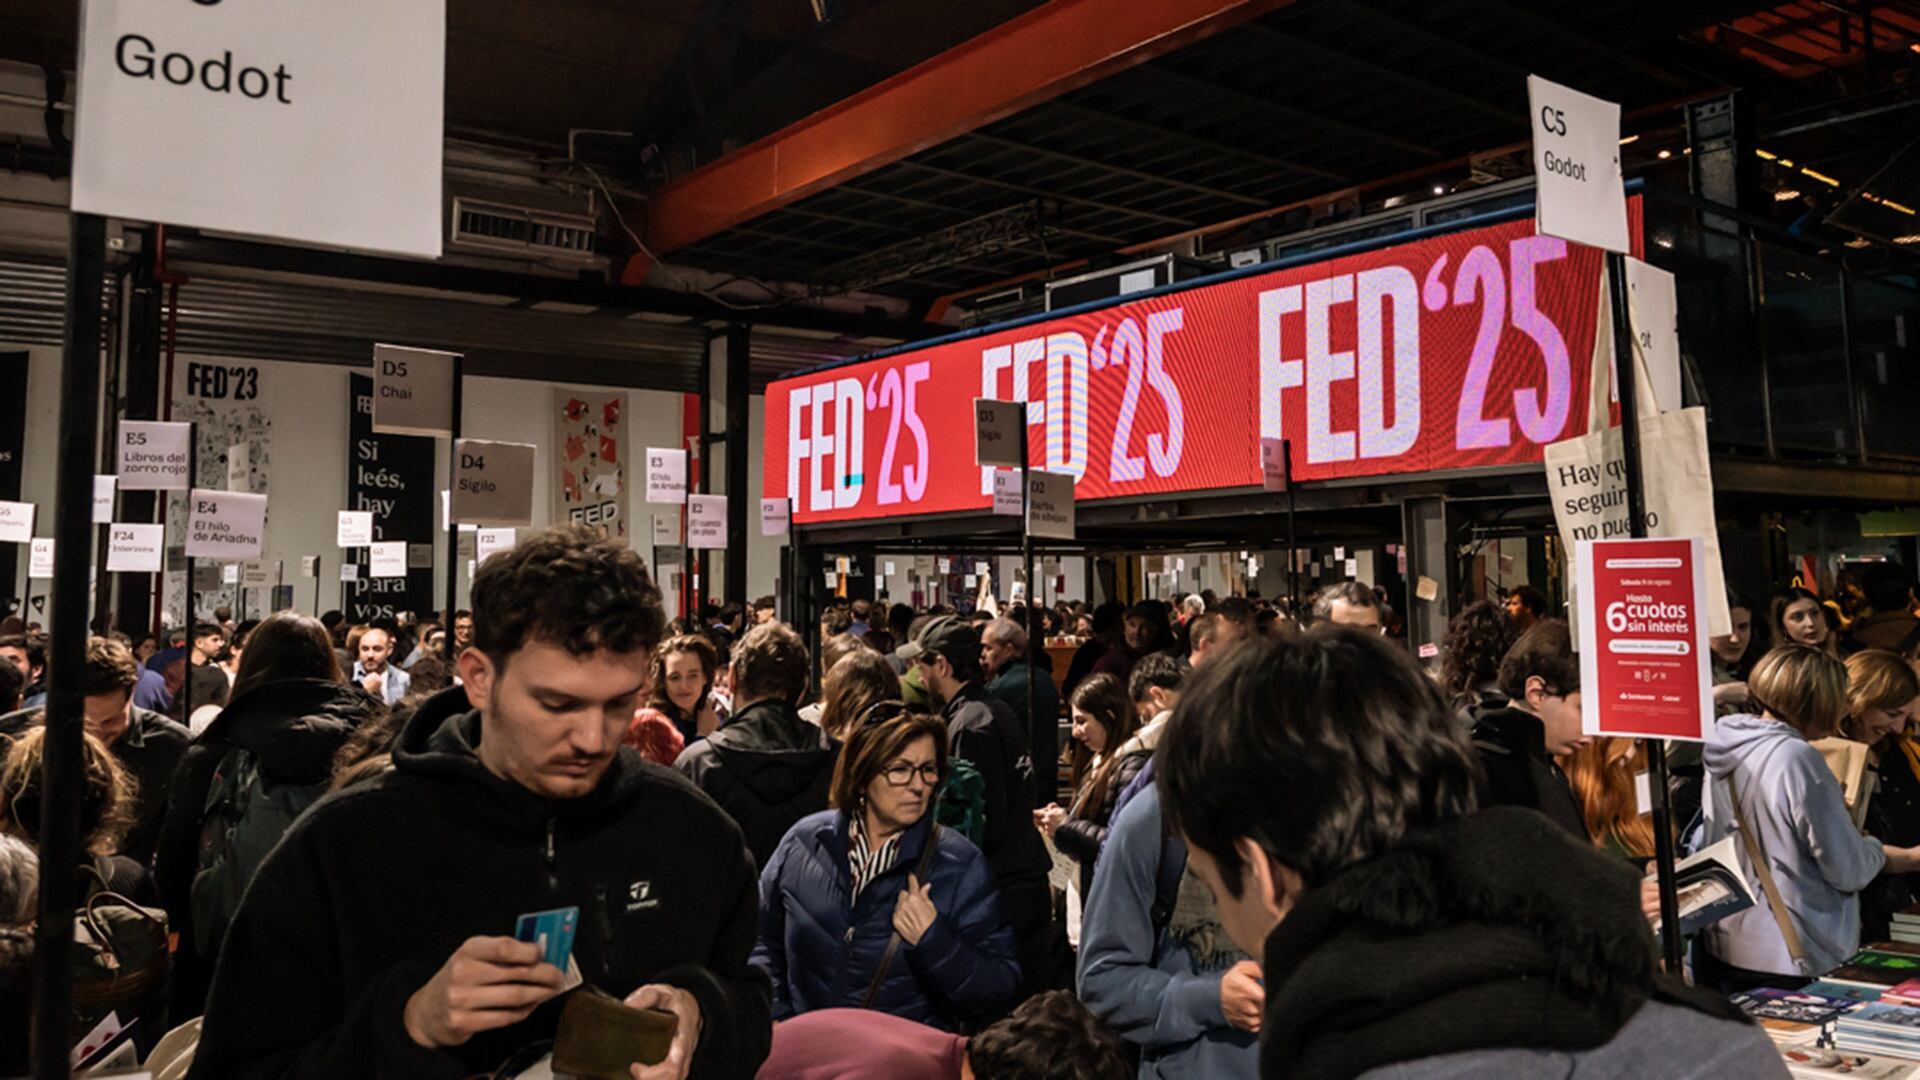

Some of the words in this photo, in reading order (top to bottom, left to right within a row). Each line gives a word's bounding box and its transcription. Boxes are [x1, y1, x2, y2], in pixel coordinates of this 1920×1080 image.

[114, 33, 292, 104] Godot
[1540, 105, 1567, 137] C5
[1543, 150, 1586, 183] Godot
[382, 360, 408, 377] D5
[380, 385, 412, 400] Chai
[357, 395, 372, 414] FE
[125, 432, 147, 446] E5
[124, 452, 165, 463] Libros
[167, 452, 187, 463] del
[358, 439, 378, 462] Si
[124, 464, 159, 473] zorro
[161, 464, 188, 475] rojo
[461, 454, 485, 471] D4
[650, 457, 663, 468] E3
[358, 465, 405, 490] leés,
[1558, 463, 1601, 487] Hay
[1606, 458, 1627, 481] qu
[459, 478, 496, 494] Sigilo
[197, 502, 217, 514] E4
[358, 492, 396, 518] hay
[692, 503, 703, 514] E2
[1565, 485, 1628, 515] seguir
[570, 500, 618, 528] FED
[195, 521, 206, 531] El
[208, 521, 230, 532] hilo
[1572, 524, 1598, 540] no
[1602, 511, 1659, 539] pueo
[113, 531, 134, 541] F24
[193, 532, 208, 542] de
[210, 533, 257, 545] Ariadna
[355, 577, 406, 597] para
[1626, 593, 1652, 603] Hasta
[355, 603, 394, 619] vos
[1606, 600, 1627, 633] 6
[1627, 604, 1687, 619] cuotas
[1627, 619, 1646, 632] sin
[1648, 620, 1689, 634] interés
